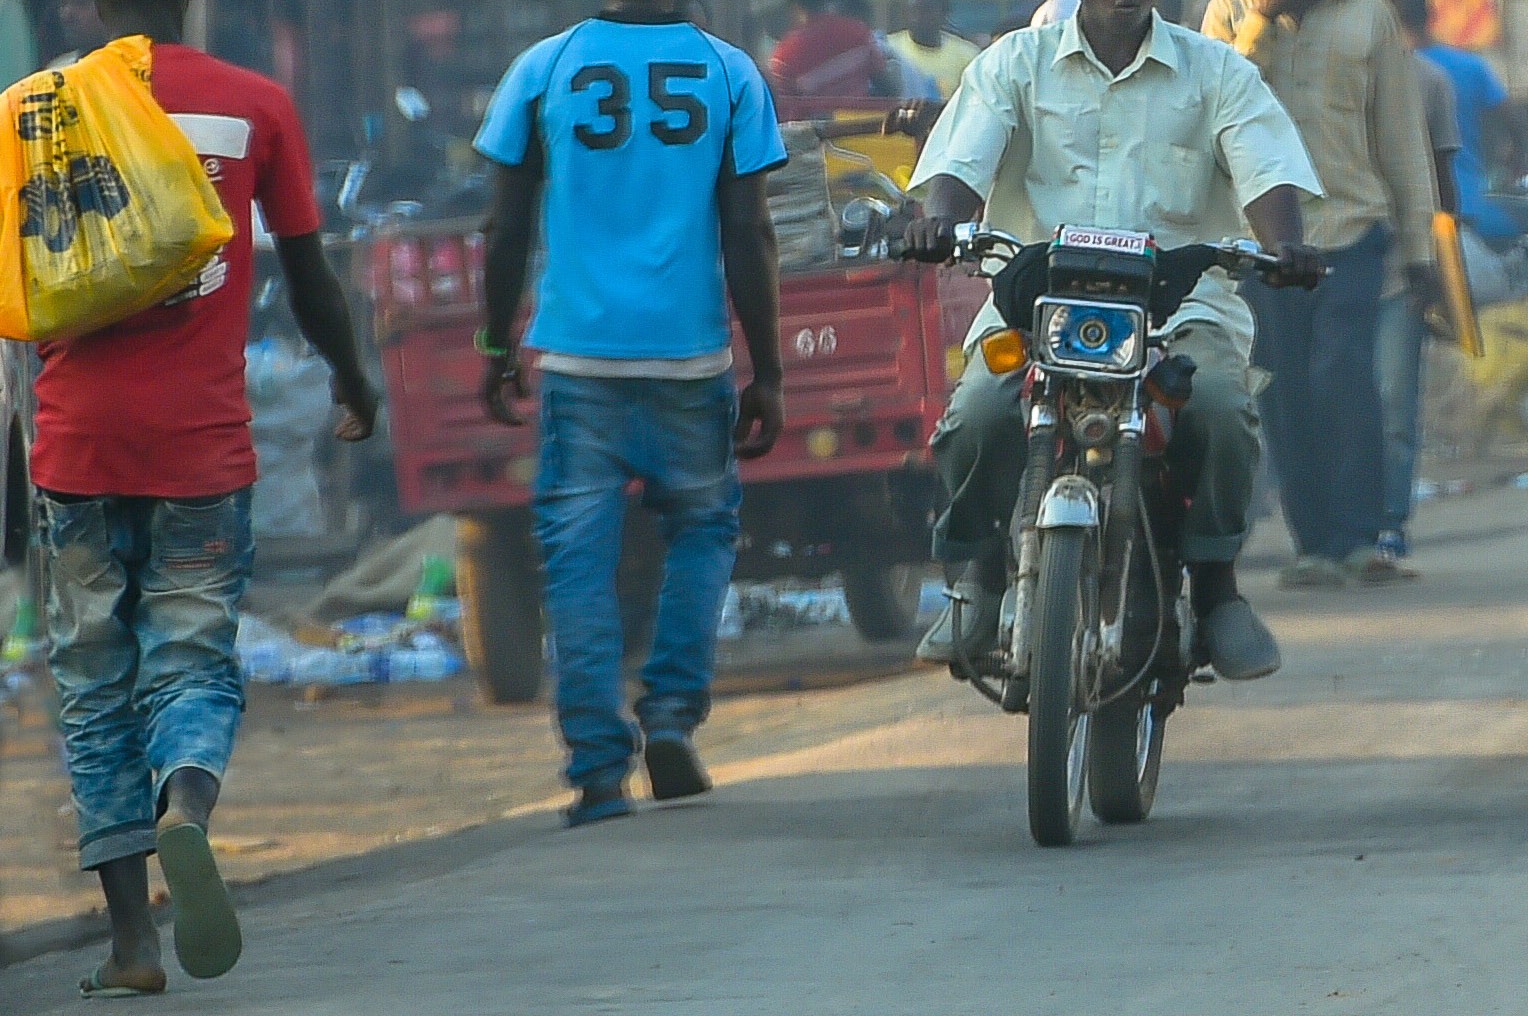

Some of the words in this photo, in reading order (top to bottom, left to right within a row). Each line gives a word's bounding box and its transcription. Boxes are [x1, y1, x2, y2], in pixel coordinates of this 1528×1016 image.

[571, 63, 710, 151] 35
[1069, 233, 1091, 245] GOD
[1092, 234, 1103, 246] IS
